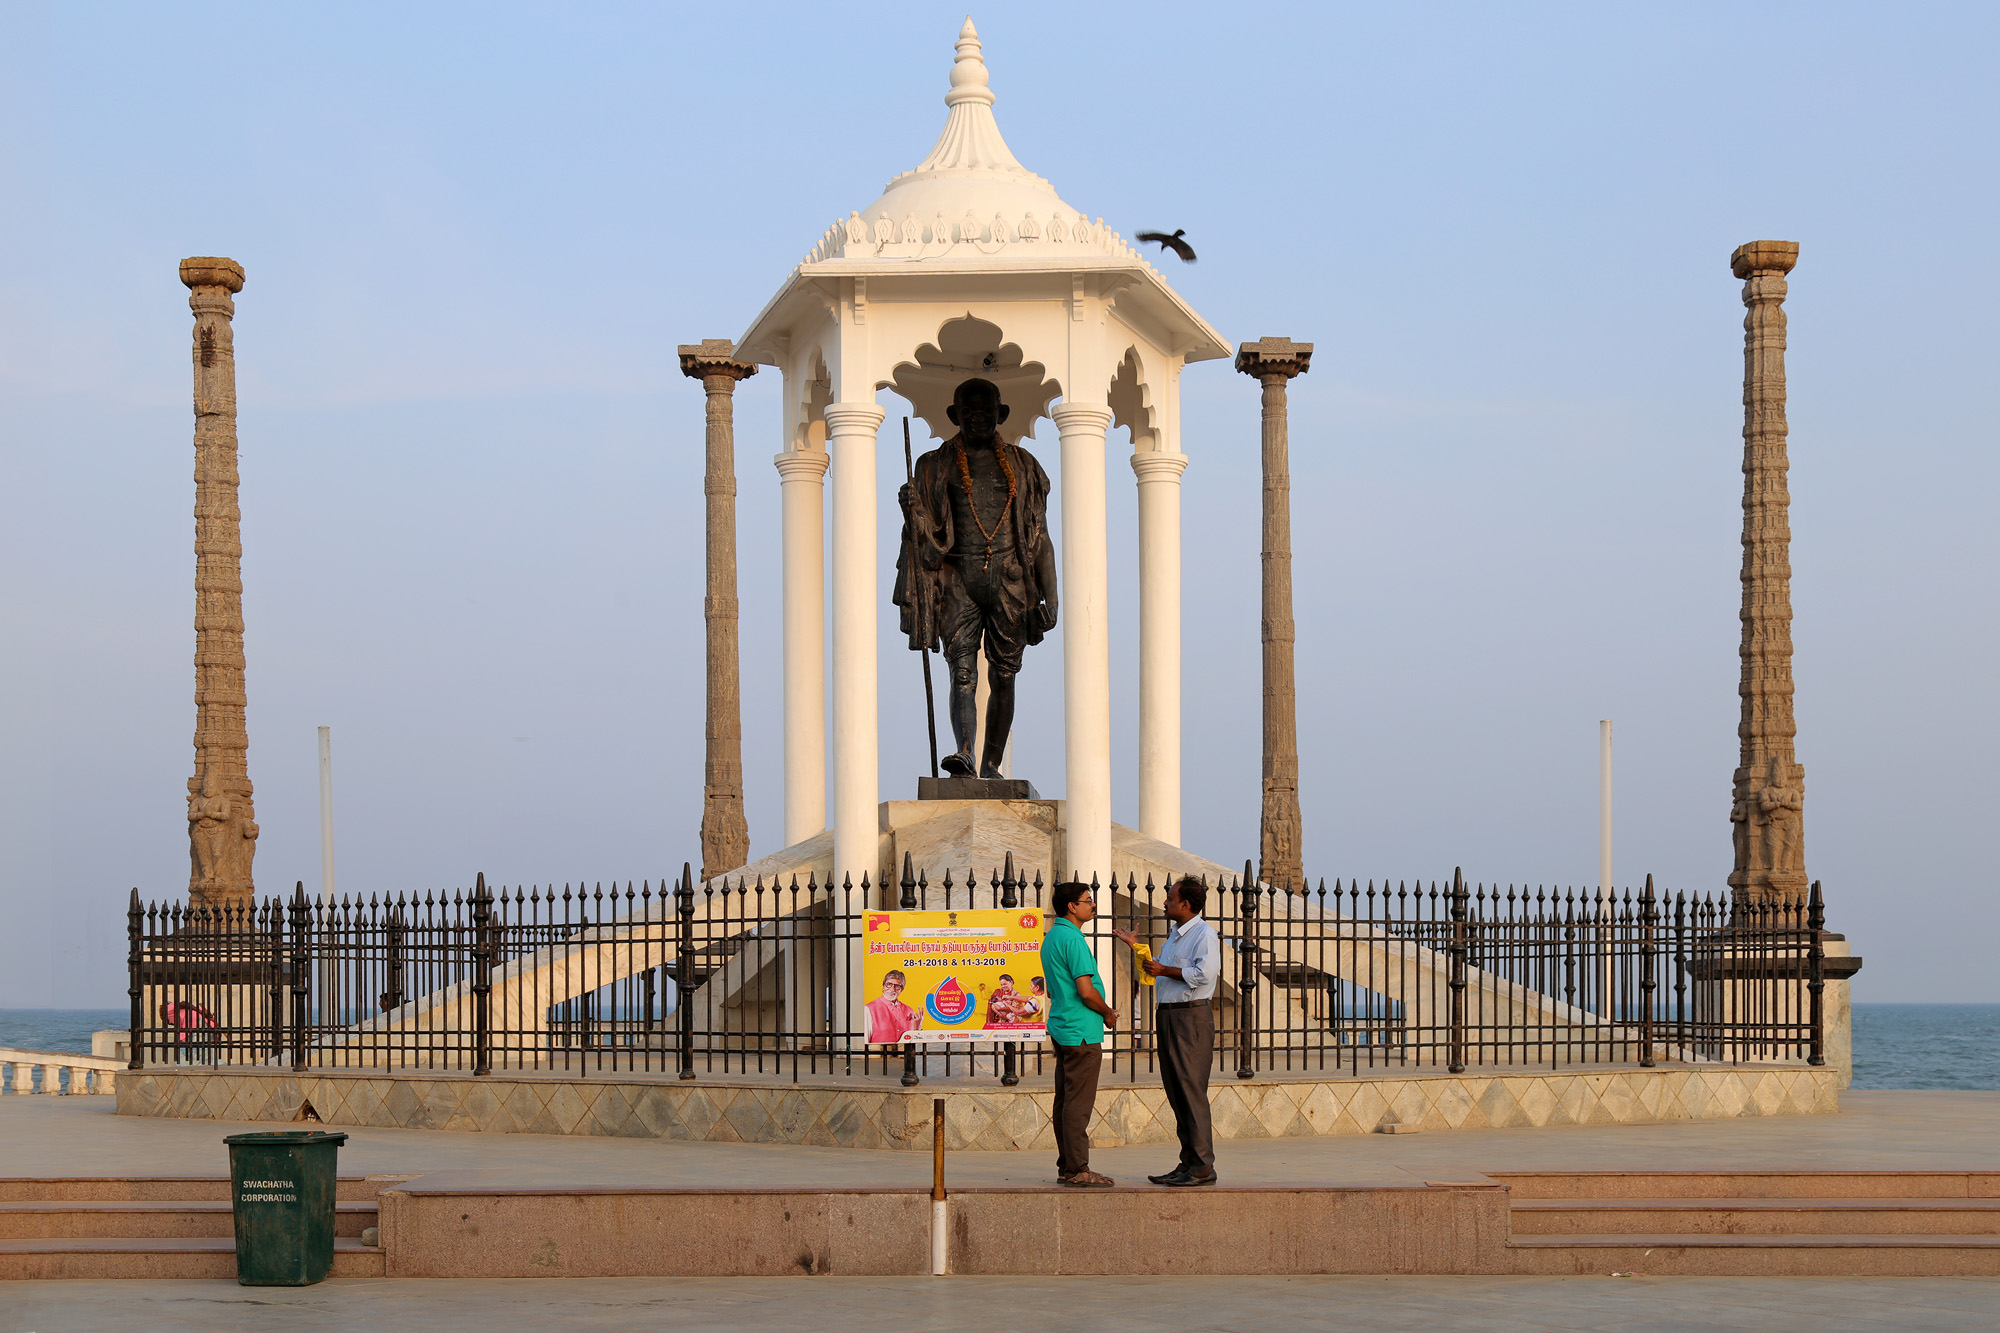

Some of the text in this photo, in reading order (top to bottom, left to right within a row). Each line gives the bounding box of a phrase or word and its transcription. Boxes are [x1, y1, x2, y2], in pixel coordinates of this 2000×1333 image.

[887, 940, 920, 953] போலியோ
[921, 939, 941, 955] நோய்
[941, 939, 962, 954] தடுப்பு
[962, 939, 987, 954] மருந்து
[988, 939, 1012, 953] போடும்
[1013, 938, 1040, 954] நாட்கள்
[903, 957, 1006, 967] 28-1-2018 & 11-3-2018
[243, 1180, 294, 1189] SWACHATHA
[241, 1193, 297, 1202] CORPORATION
